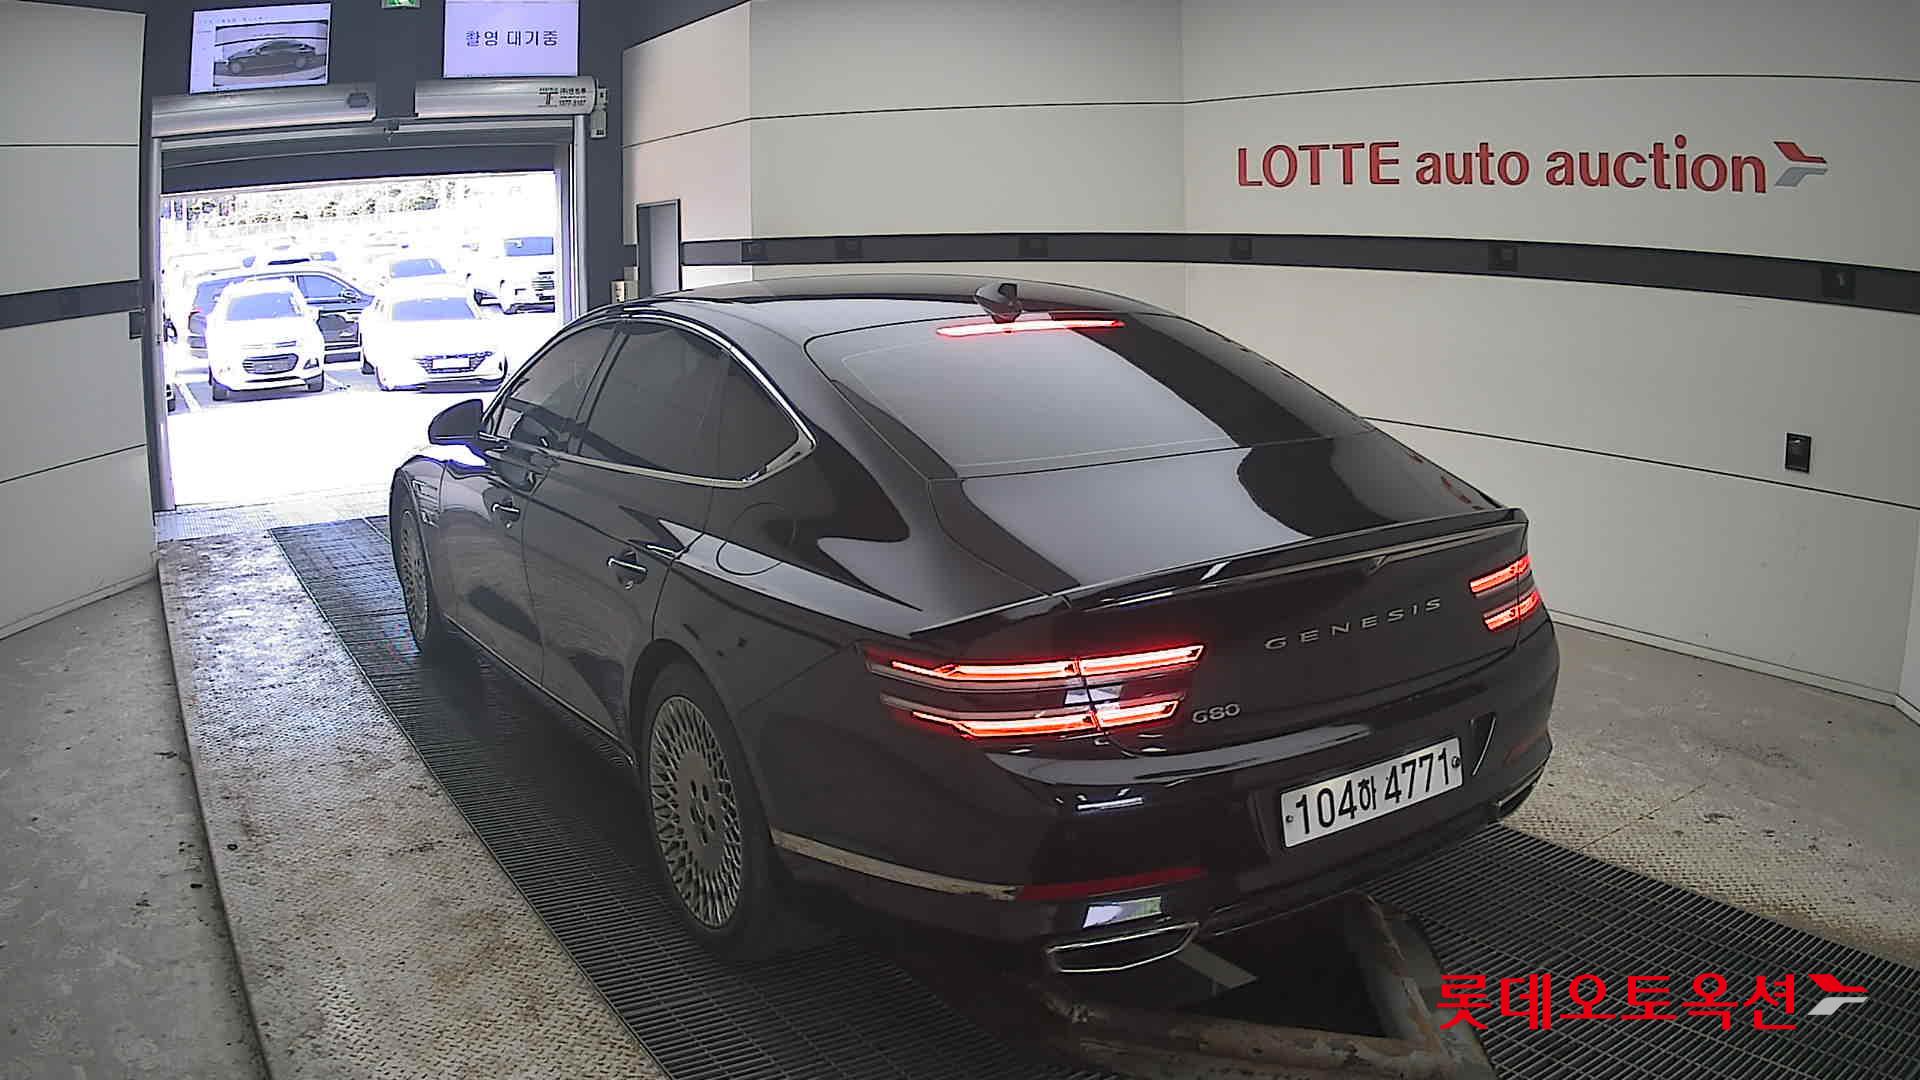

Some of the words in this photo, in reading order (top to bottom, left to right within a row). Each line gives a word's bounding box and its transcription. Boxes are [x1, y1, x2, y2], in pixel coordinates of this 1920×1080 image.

[465, 30, 498, 47] 촬영
[507, 30, 558, 47] 대기중
[1238, 141, 1400, 187] LOTTE
[1416, 142, 1530, 186] auto
[1545, 134, 1767, 194] auction
[1264, 599, 1441, 650] GENESIS
[1192, 703, 1241, 724] G80
[1295, 776, 1377, 834] 104하
[1384, 747, 1450, 803] 4771
